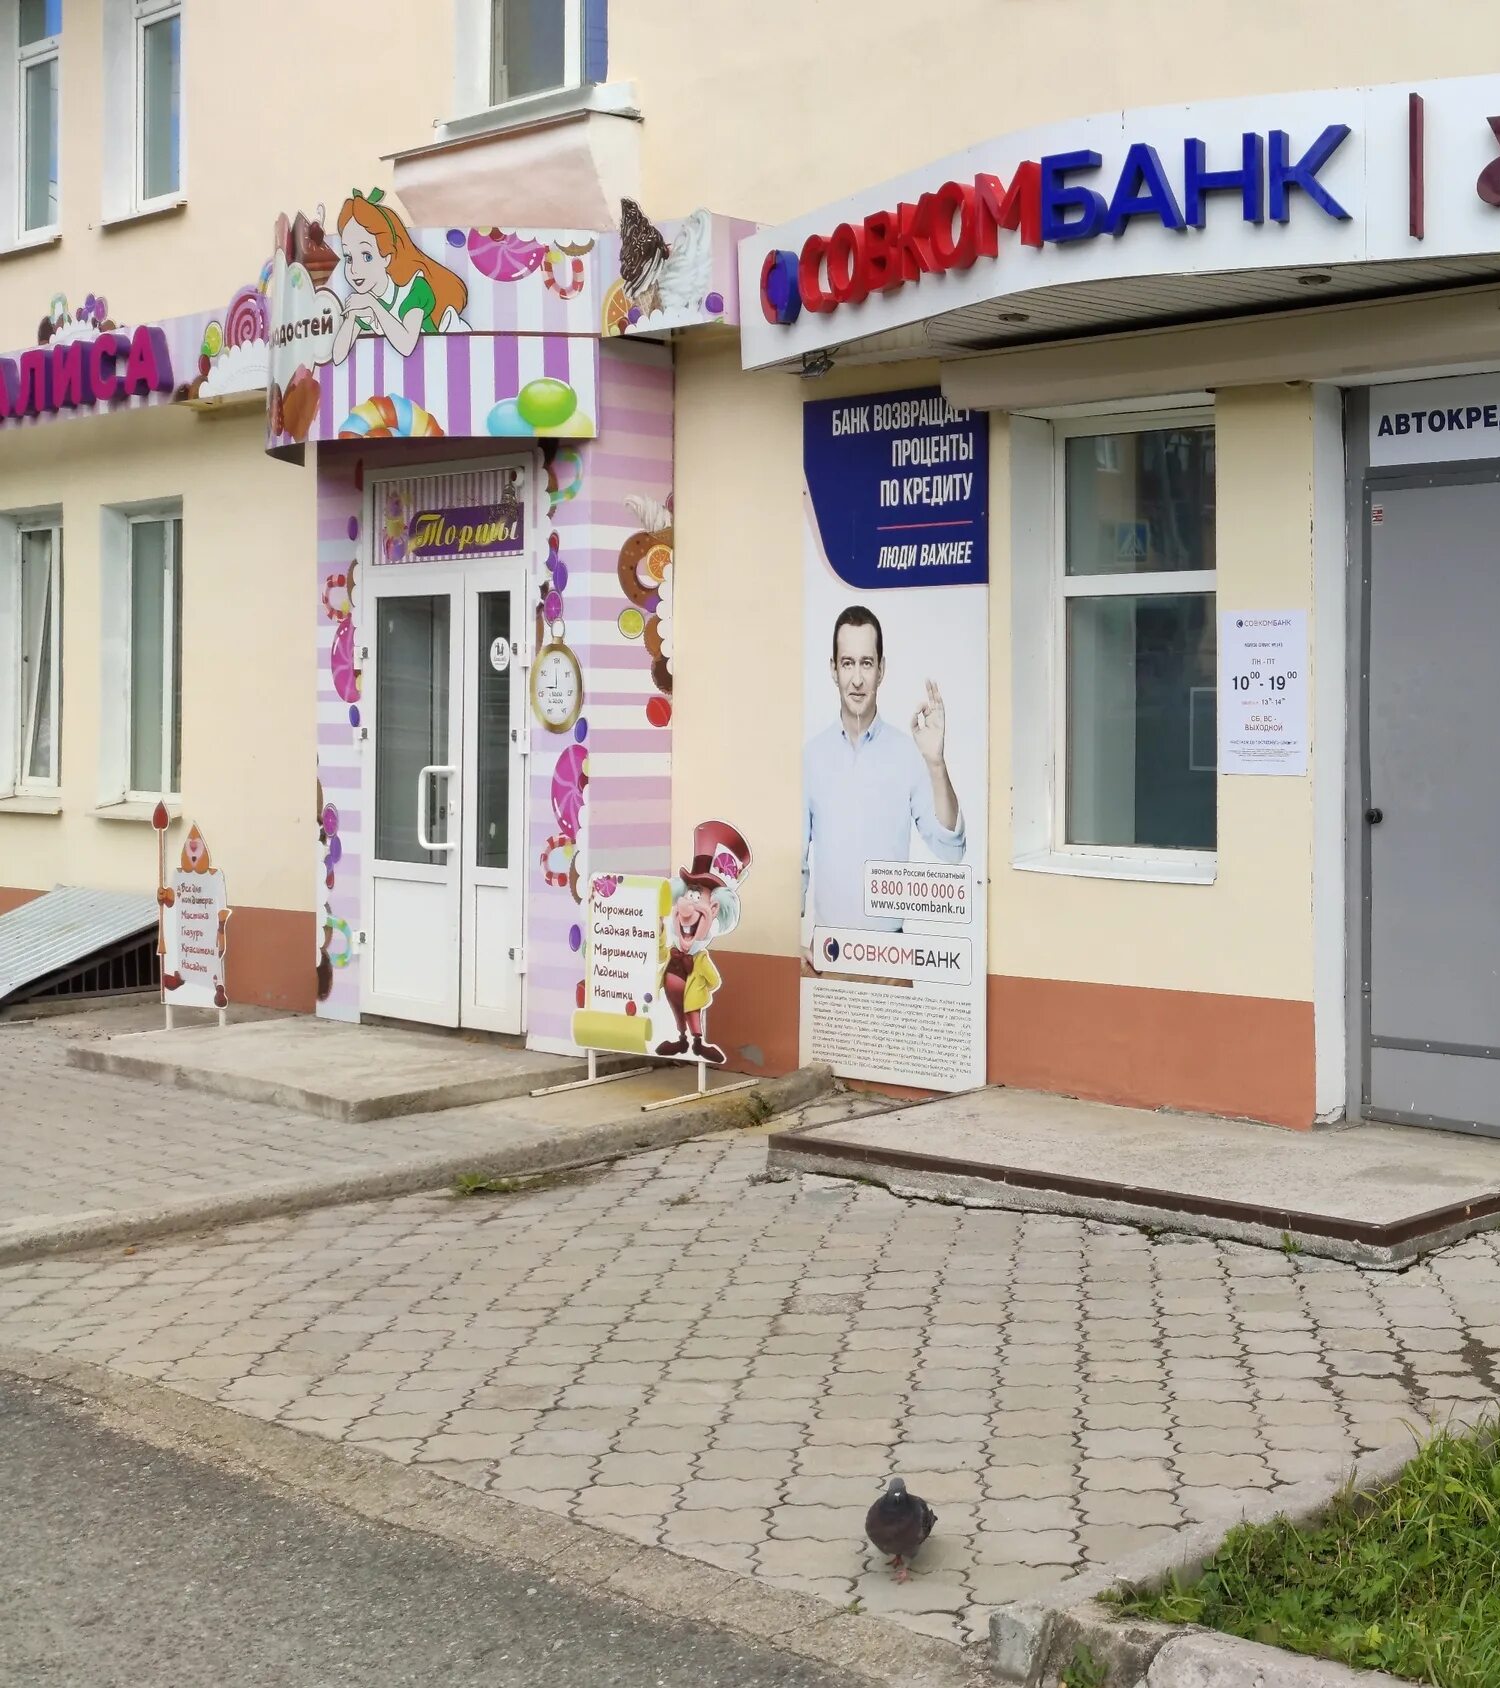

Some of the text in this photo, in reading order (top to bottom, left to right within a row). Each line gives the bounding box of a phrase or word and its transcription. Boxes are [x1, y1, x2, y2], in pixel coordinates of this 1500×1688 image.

[799, 123, 1352, 313] СОВКОМБАНК
[0, 325, 174, 417] ЛИСА
[832, 406, 870, 436] БАНК
[892, 432, 974, 467] ПРОЦЕНТЫ
[880, 472, 974, 507] ПО КРЕДИТУ
[877, 541, 974, 570] ЛЮДИ ВАЖНЕЕ
[1244, 619, 1292, 628] СОВКОМБАНК
[871, 868, 894, 876] звонок
[904, 868, 926, 878] России
[926, 870, 966, 880] бесплатный
[871, 880, 965, 900] 8 800 100 000 6
[181, 910, 209, 920] Мастика
[594, 902, 644, 920] Мороженое
[870, 900, 966, 915] www.sovcombank.ru
[594, 922, 656, 940] Сладкая вата
[594, 944, 648, 964] Маршмеллоу
[842, 942, 961, 970] СОВКОМБАНК
[594, 964, 630, 980] Леденцы
[594, 986, 634, 1000] Напитки
